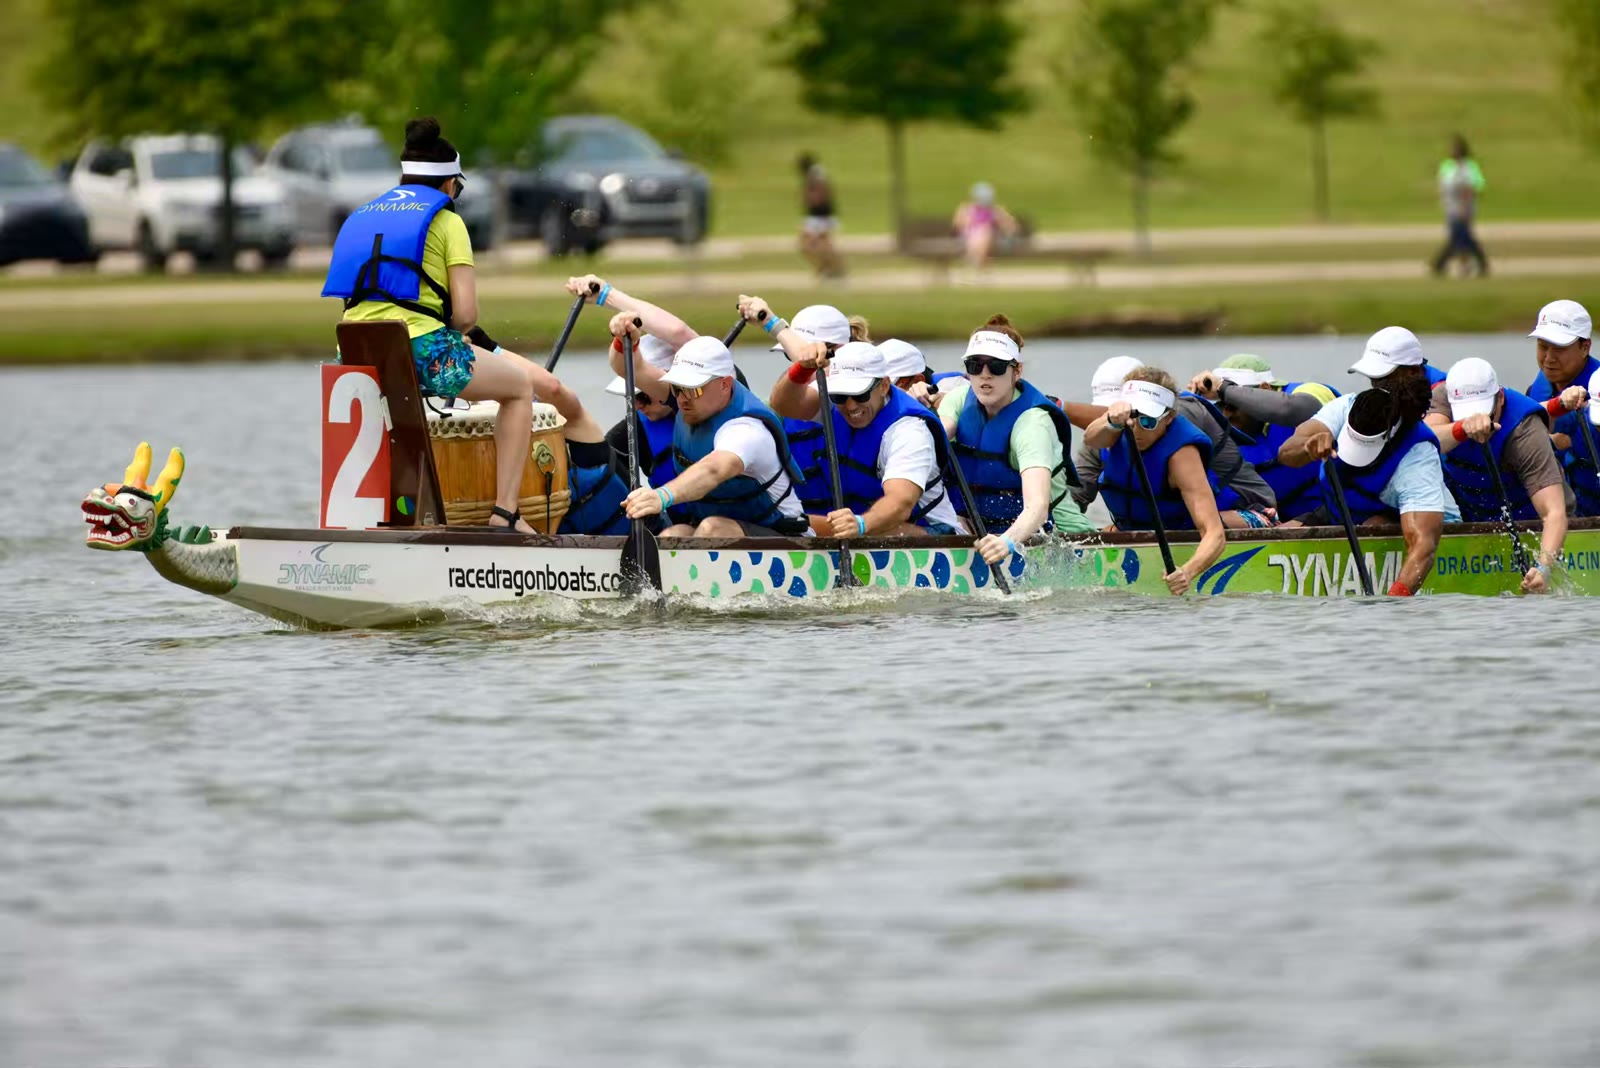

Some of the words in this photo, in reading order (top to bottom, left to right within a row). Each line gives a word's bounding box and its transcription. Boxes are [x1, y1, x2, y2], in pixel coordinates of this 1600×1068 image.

[358, 202, 430, 213] DYNAMIC
[325, 371, 385, 529] 2
[277, 563, 372, 585] DYNAMIC
[1267, 551, 1403, 597] DYNAMI
[1437, 554, 1504, 576] DRAGON
[448, 562, 621, 597] racedragonboats.co
